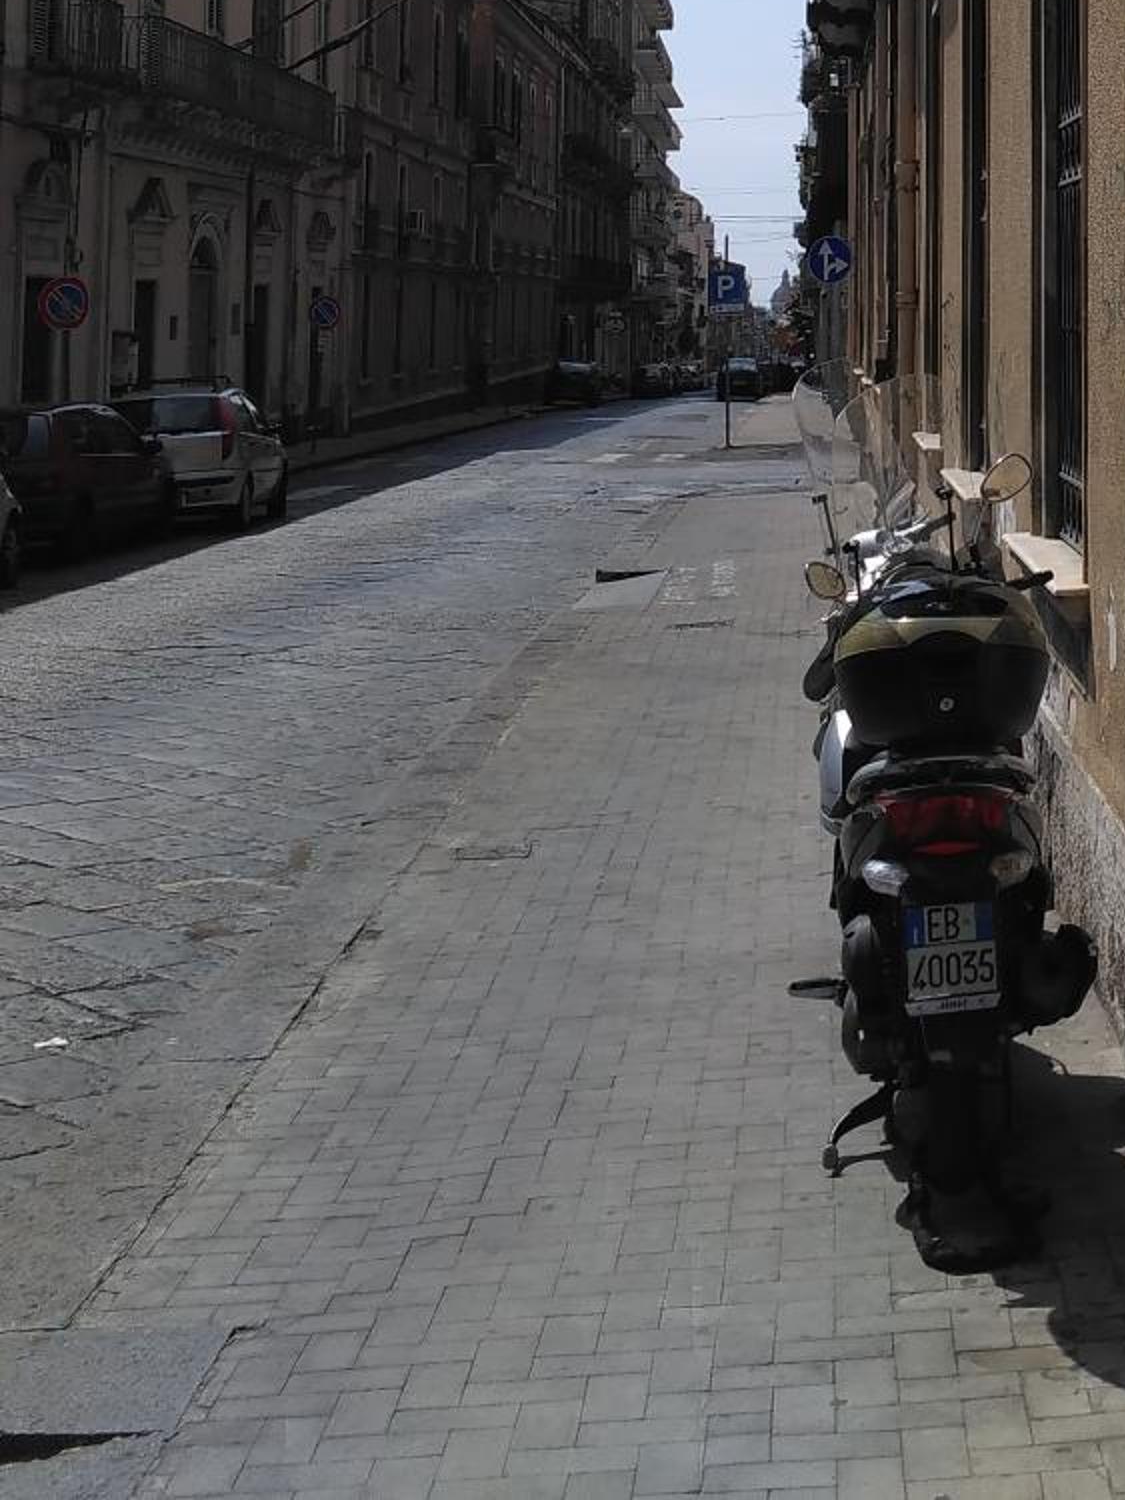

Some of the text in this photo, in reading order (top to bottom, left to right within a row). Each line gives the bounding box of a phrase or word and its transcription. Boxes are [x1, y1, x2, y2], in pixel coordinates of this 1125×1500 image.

[717, 275, 736, 299] P
[927, 906, 960, 942] EB
[911, 948, 995, 990] 40035
